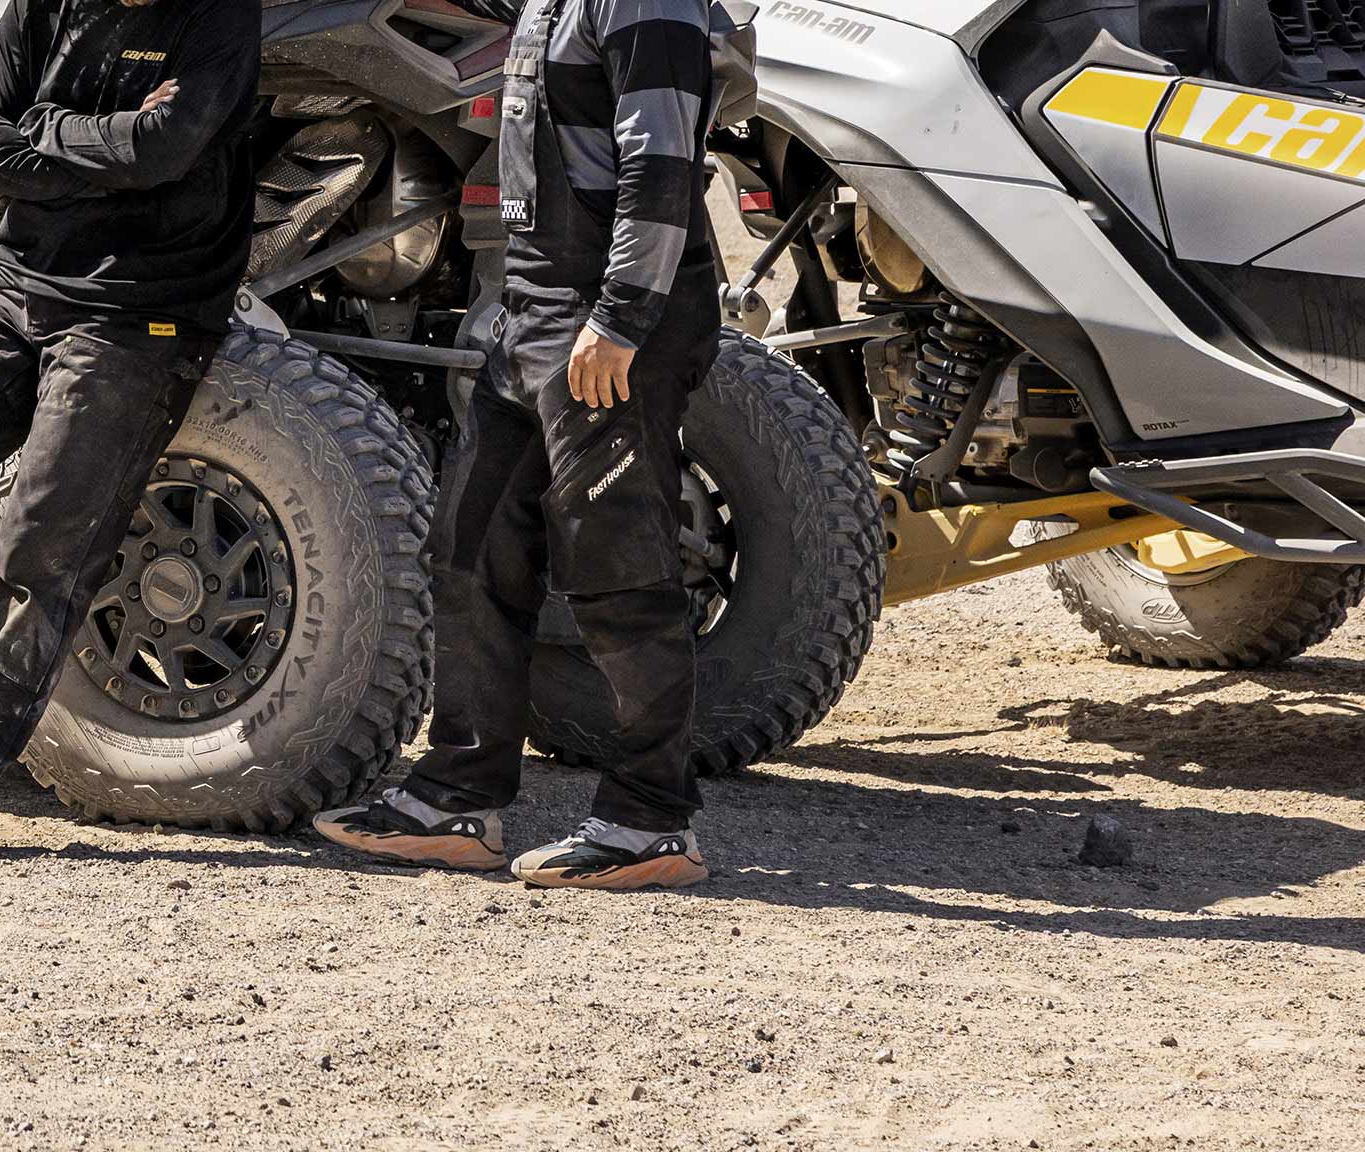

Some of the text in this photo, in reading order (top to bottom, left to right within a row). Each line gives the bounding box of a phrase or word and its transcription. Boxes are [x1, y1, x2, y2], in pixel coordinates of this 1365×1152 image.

[765, 0, 876, 46] can-am
[1142, 421, 1178, 431] ROTAX
[589, 449, 637, 501] FASTHOUSE
[283, 488, 325, 681] TENACITY
